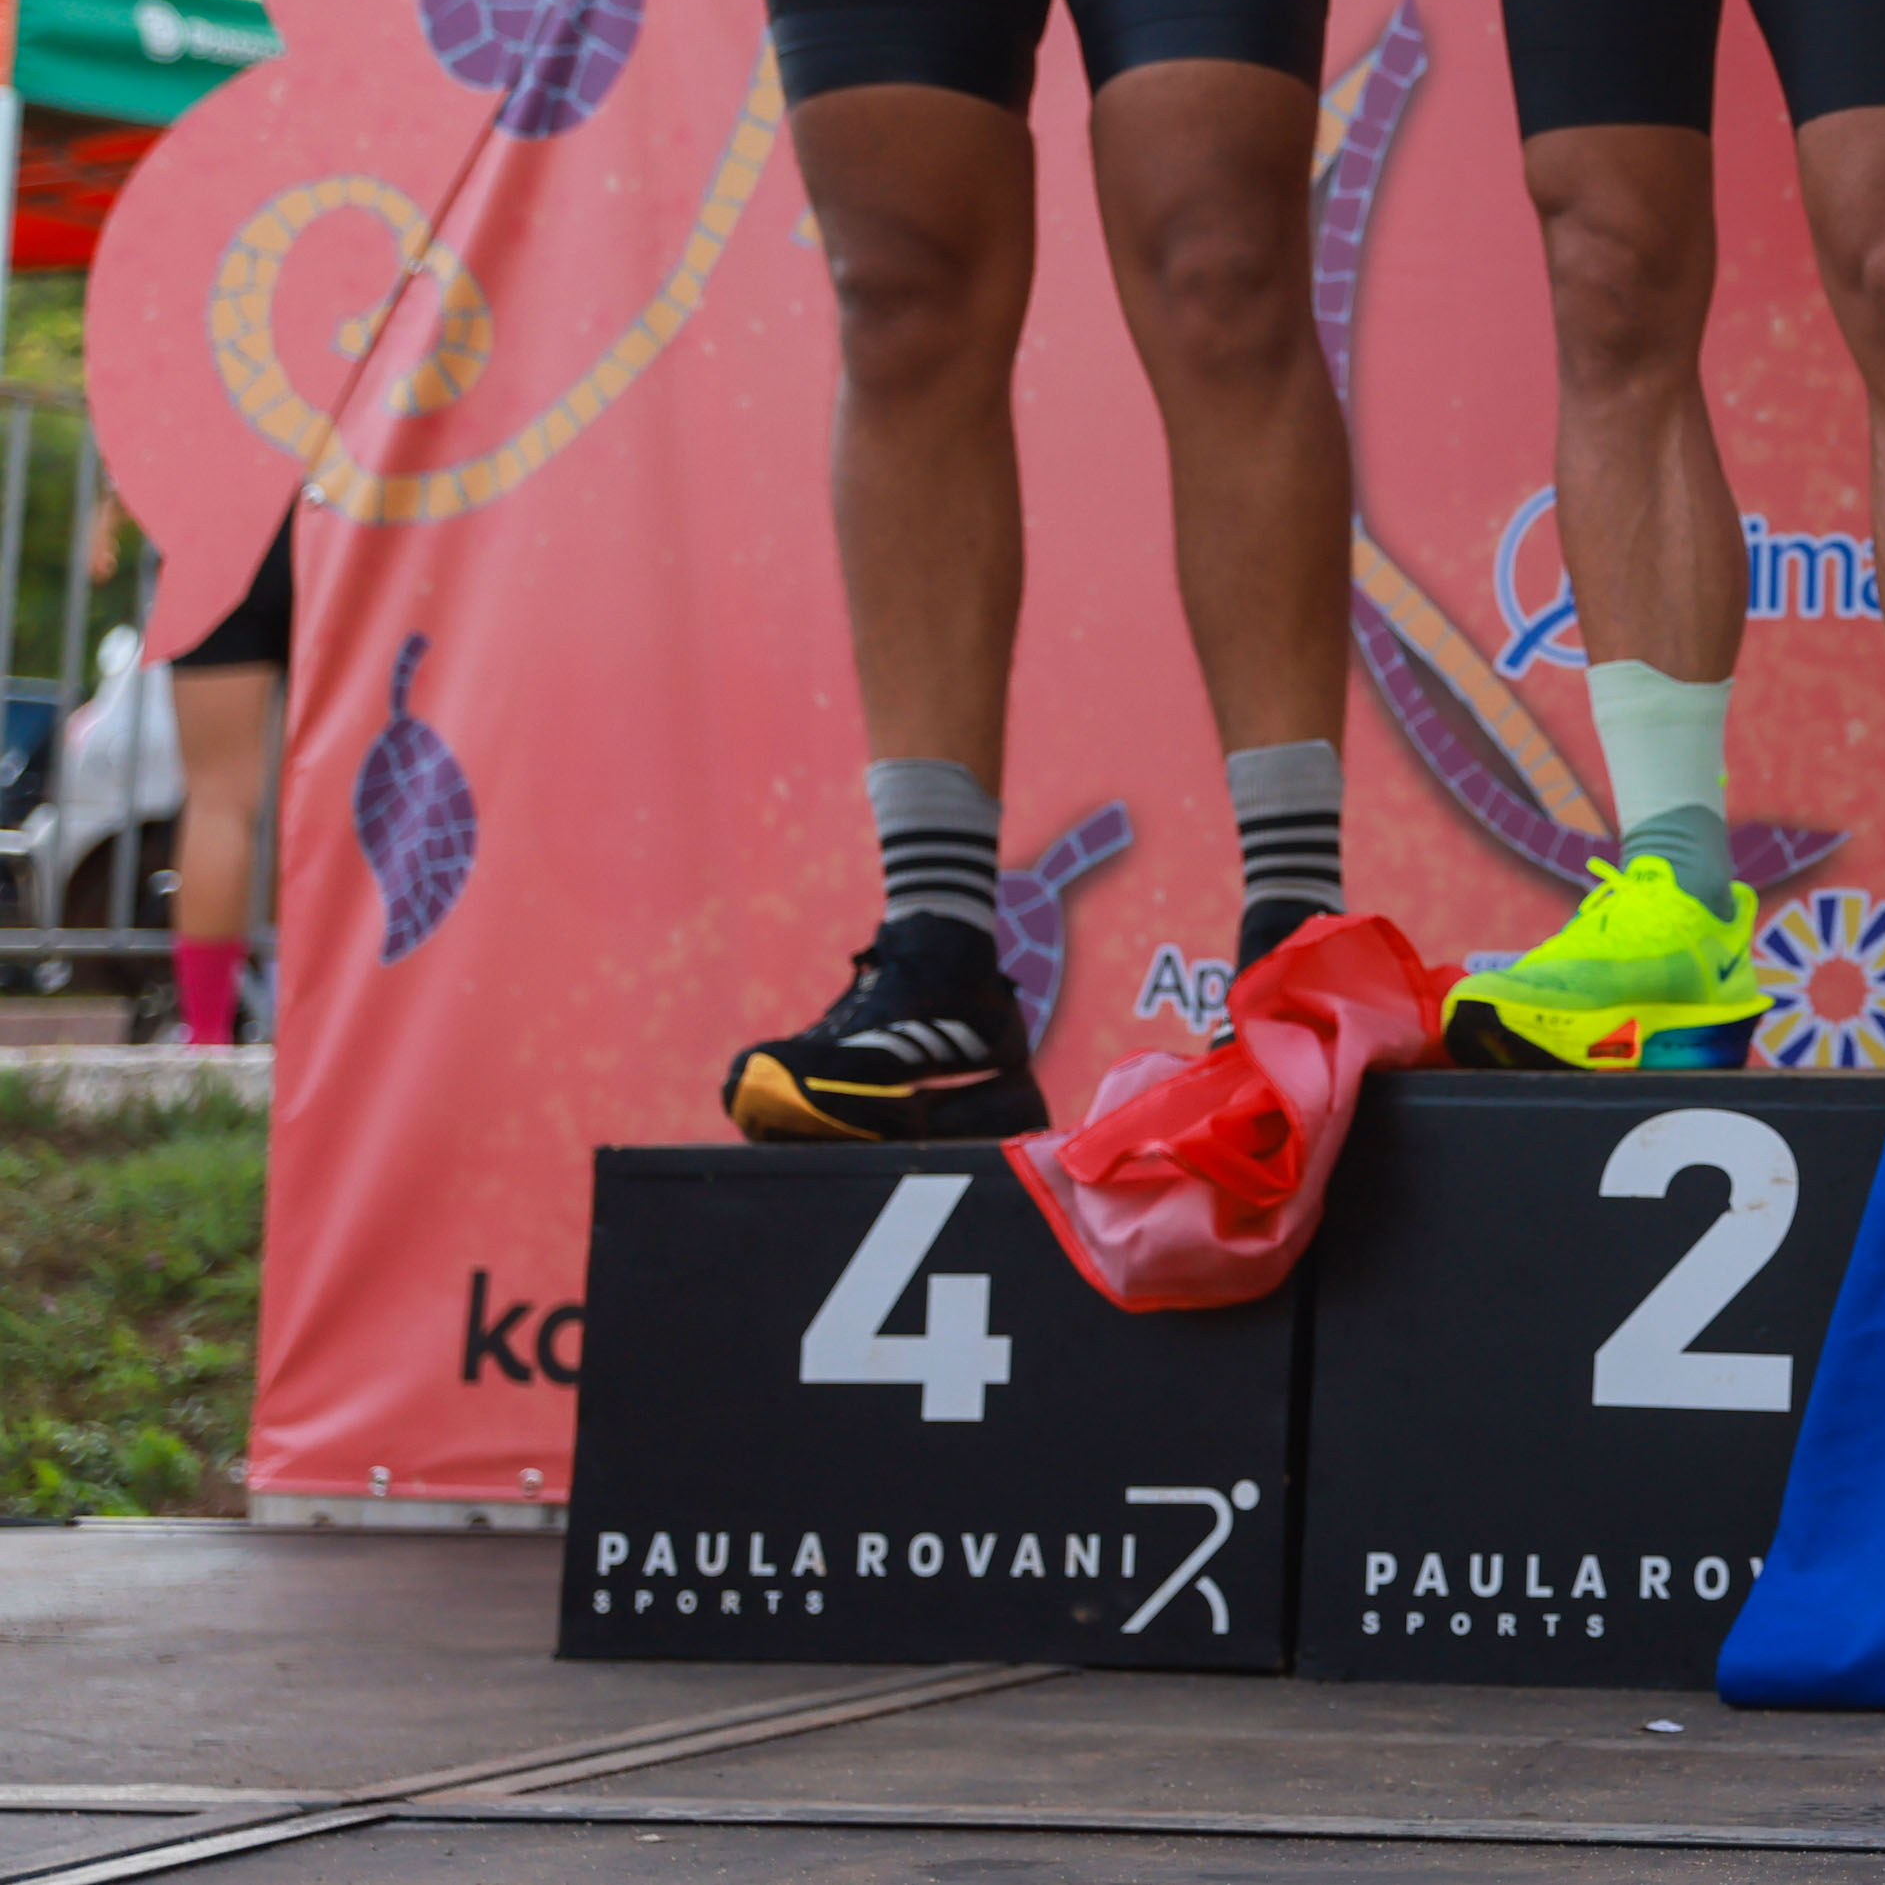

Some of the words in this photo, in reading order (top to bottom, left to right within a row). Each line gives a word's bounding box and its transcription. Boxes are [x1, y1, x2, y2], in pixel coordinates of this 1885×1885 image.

[1593, 1108, 1799, 1414] 2
[800, 1173, 1012, 1423] 4
[598, 1530, 828, 1582] PAULA
[857, 1530, 1137, 1582] ROVANI
[1365, 1550, 1604, 1601] PAULA
[591, 1588, 827, 1616] SPORTS
[1361, 1611, 1607, 1639] SPORTS
